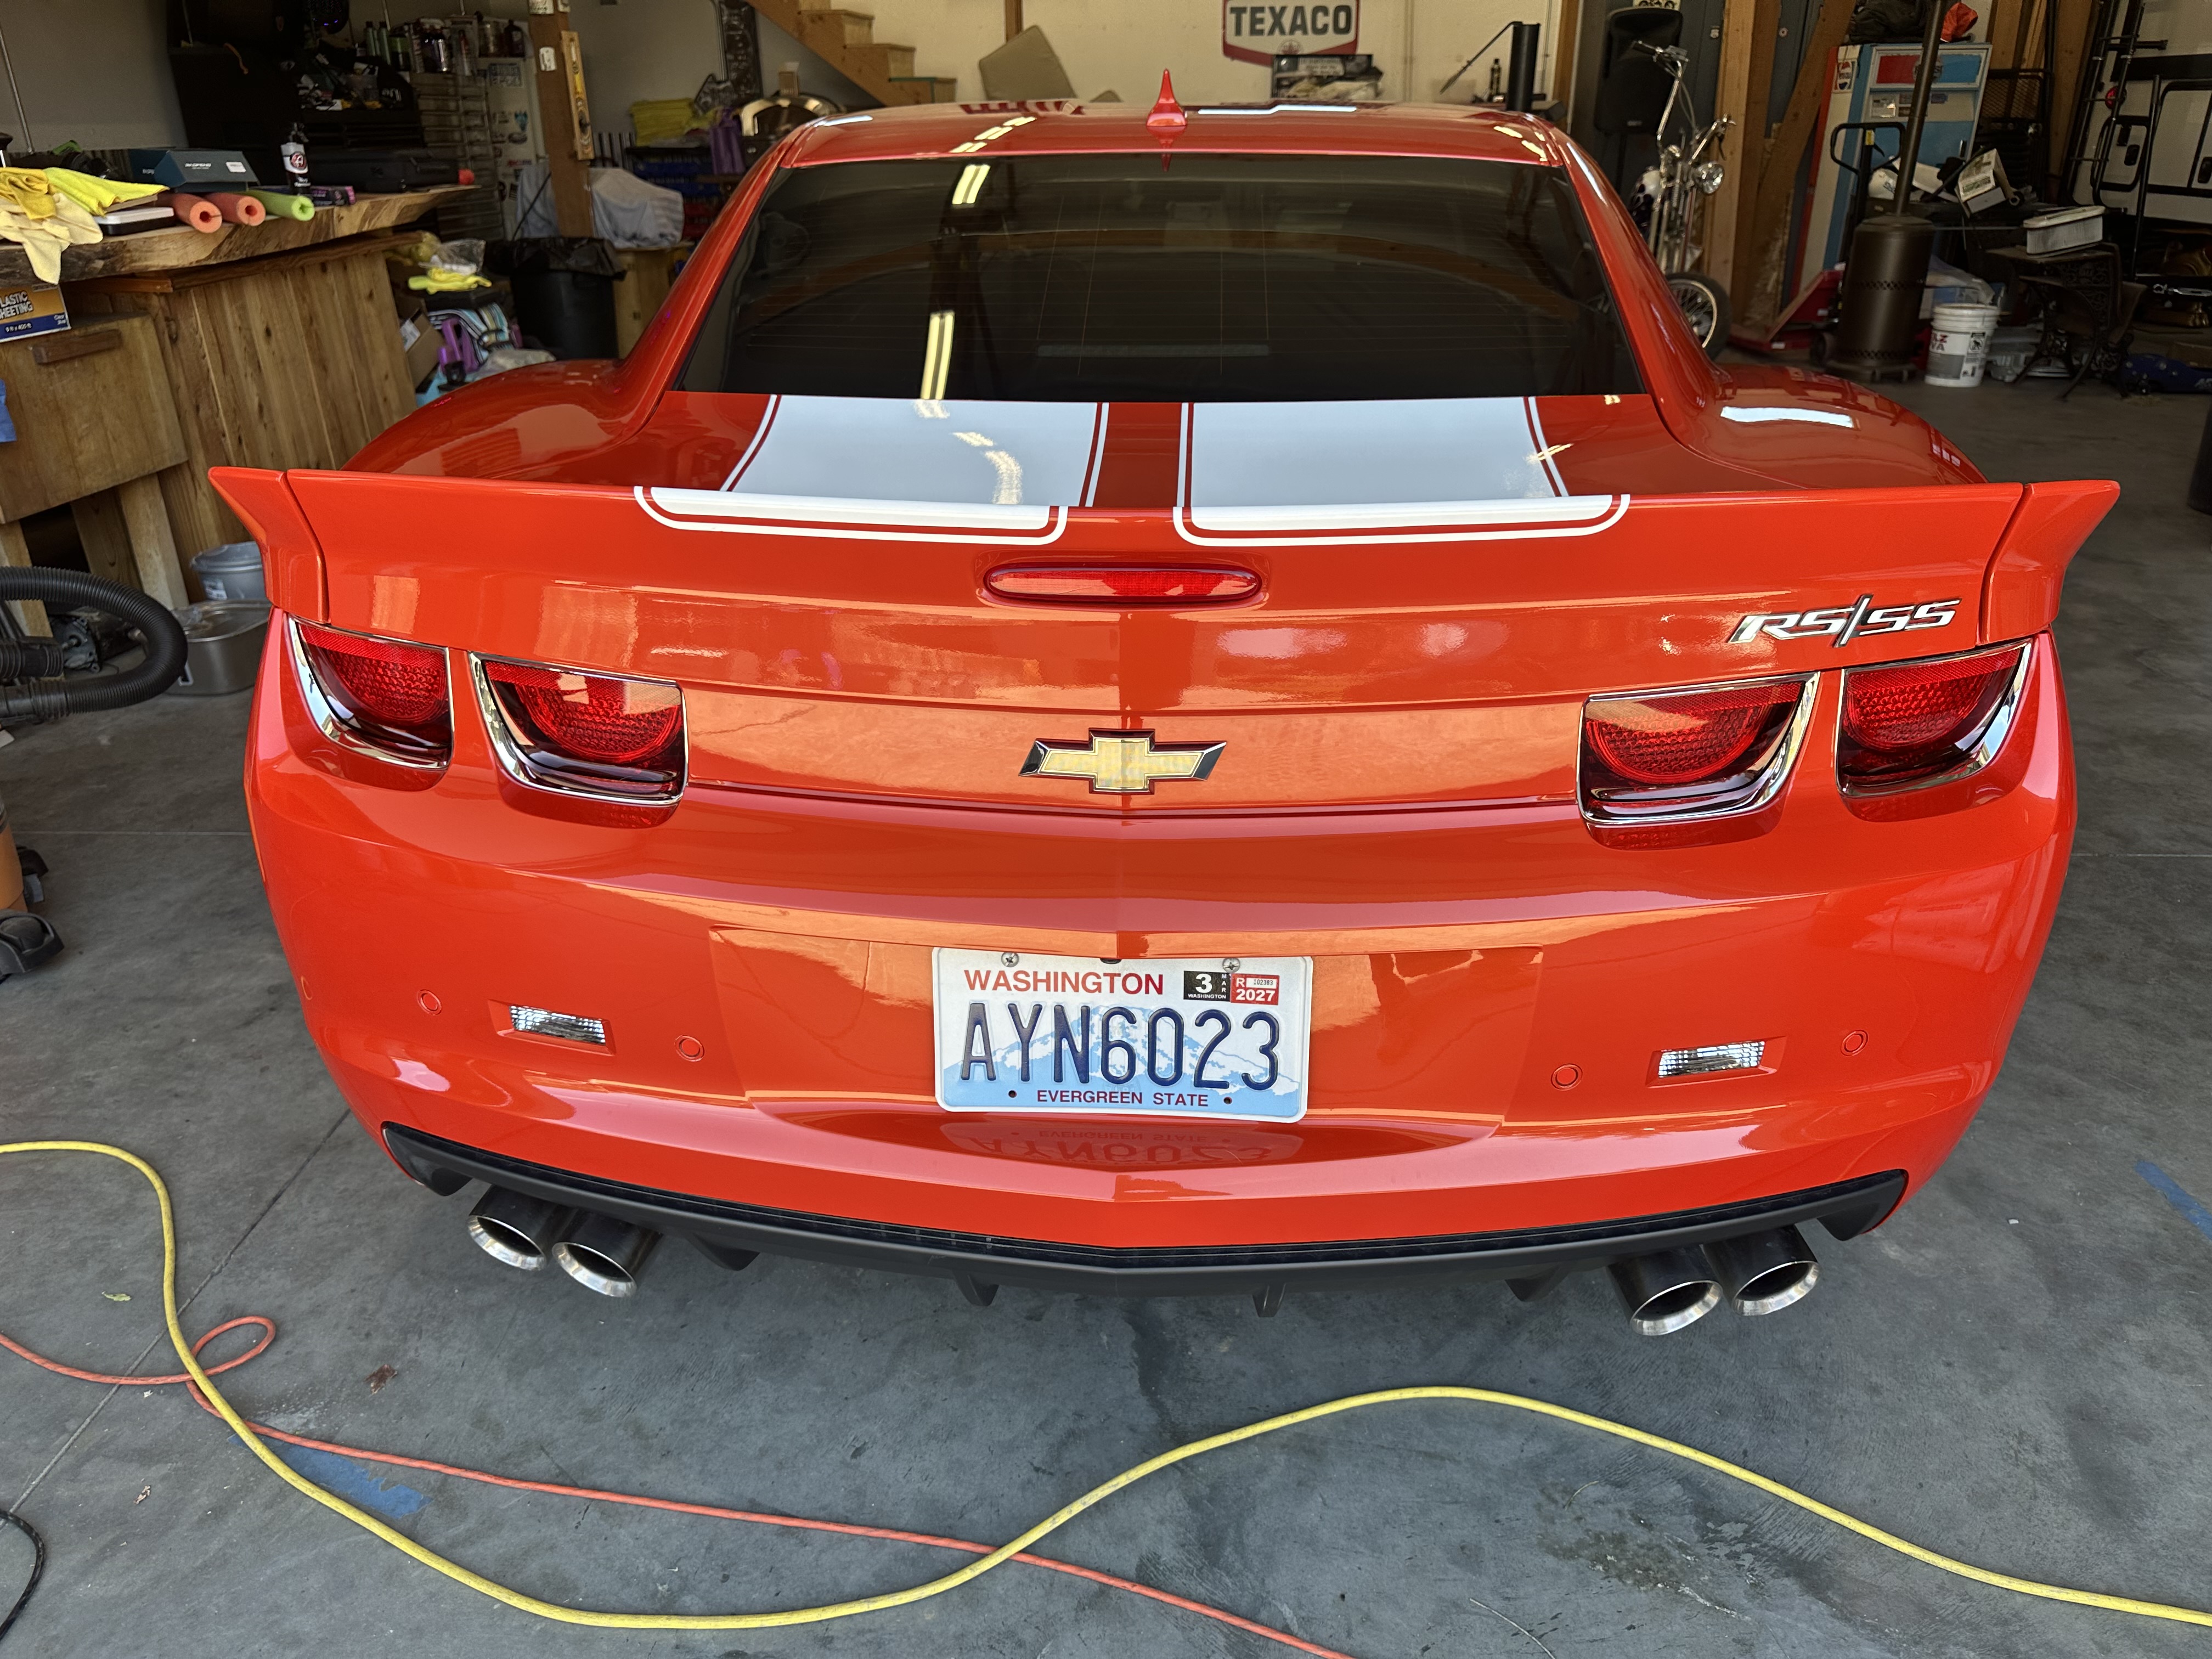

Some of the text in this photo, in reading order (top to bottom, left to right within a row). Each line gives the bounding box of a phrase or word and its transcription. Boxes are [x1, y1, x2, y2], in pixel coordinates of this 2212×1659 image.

[1229, 5, 1352, 36] TEXACO
[0, 290, 28, 308] LASTIC
[0, 301, 33, 319] HEETING
[964, 969, 1163, 995] WASHINGTON
[1195, 973, 1212, 994] 3
[1236, 978, 1245, 988] R
[1235, 989, 1276, 1002] 2027
[961, 1002, 1280, 1091] AYN6023
[1037, 1090, 1209, 1107] EVERGREEN STATE
